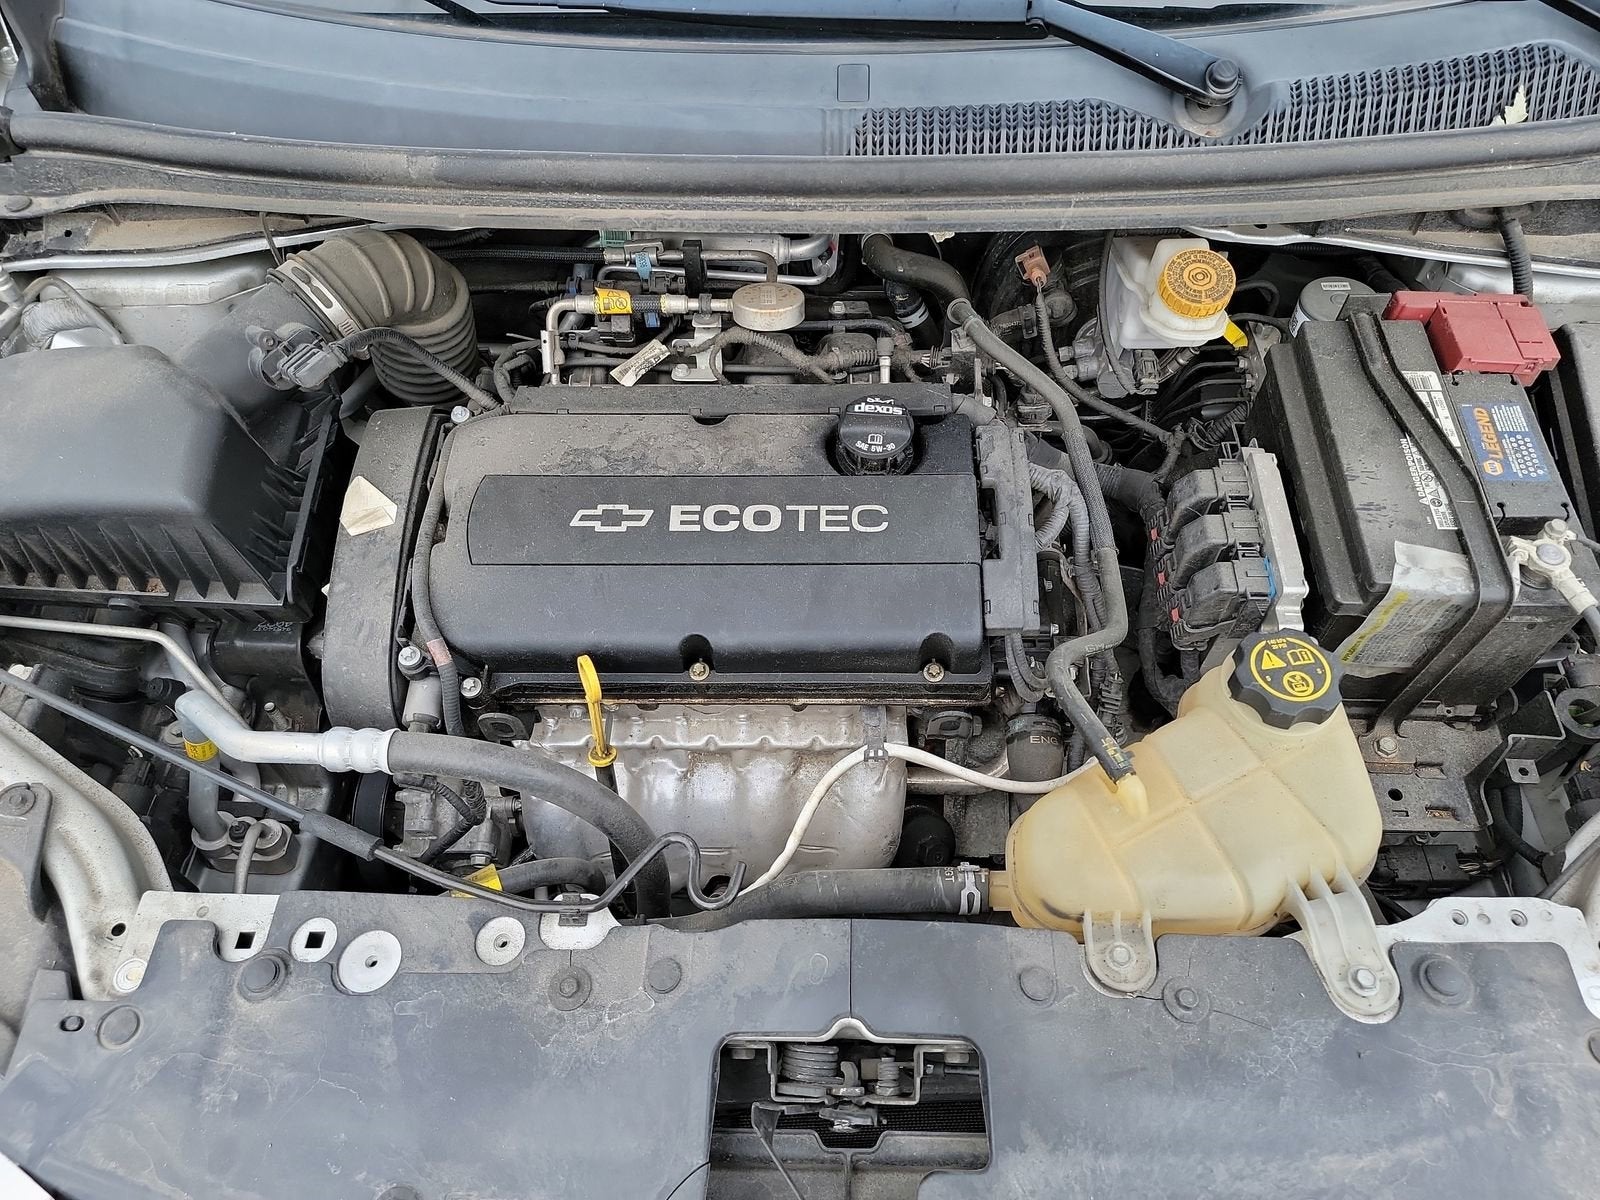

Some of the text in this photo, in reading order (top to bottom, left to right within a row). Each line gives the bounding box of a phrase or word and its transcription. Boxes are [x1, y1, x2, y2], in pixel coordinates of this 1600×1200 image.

[854, 403, 903, 415] dexos
[1474, 408, 1503, 459] LEGEND
[855, 441, 896, 453] SAE 5W-30
[668, 504, 890, 533] ECOTEC
[1029, 735, 1058, 745] ENG
